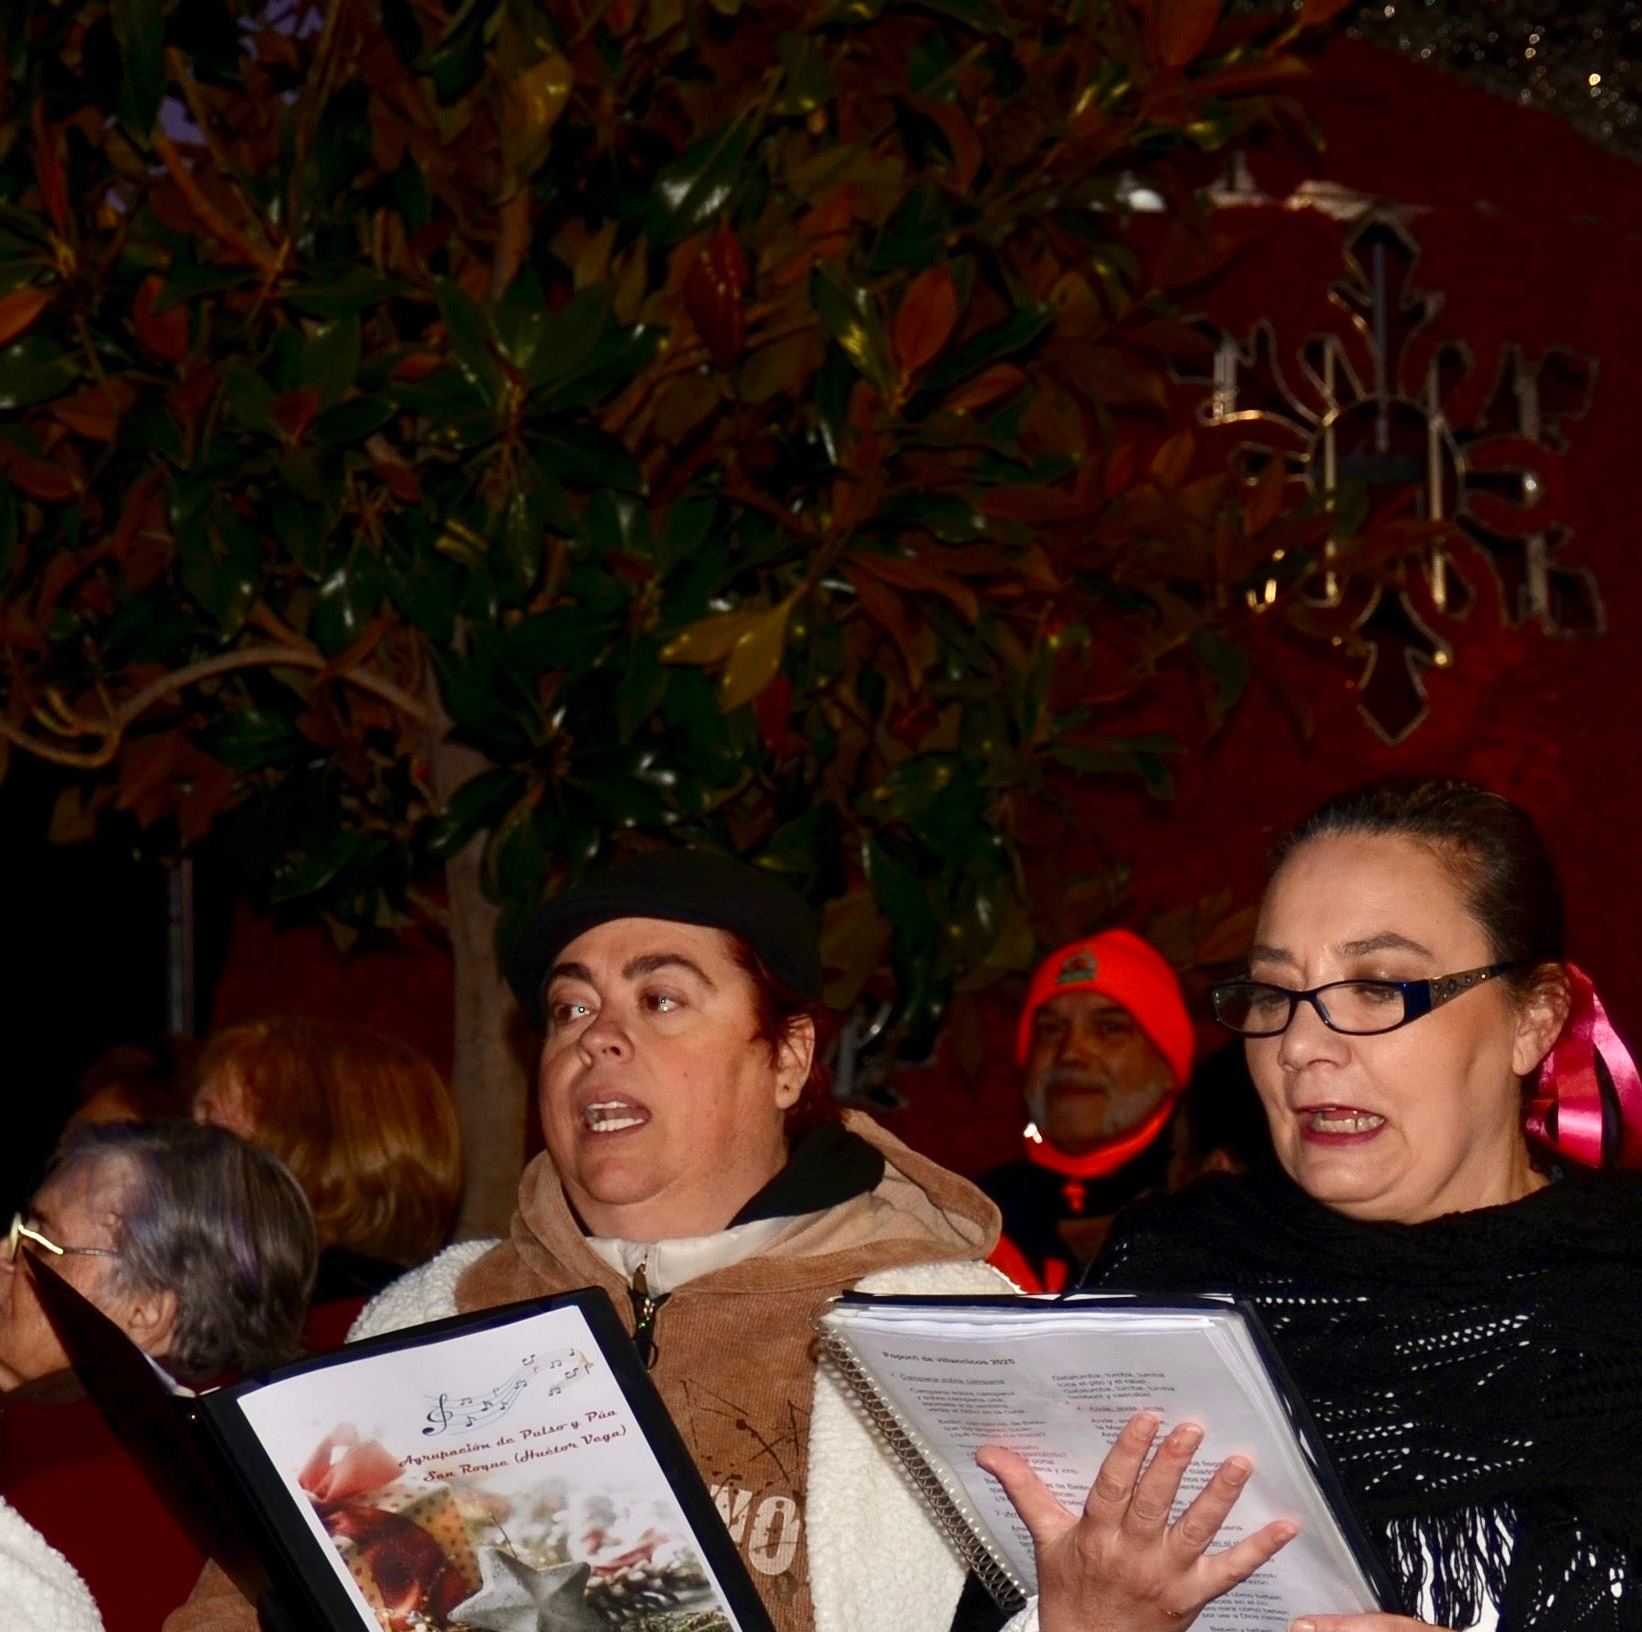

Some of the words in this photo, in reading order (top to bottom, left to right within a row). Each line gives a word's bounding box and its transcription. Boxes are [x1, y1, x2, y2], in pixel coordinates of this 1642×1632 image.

[398, 1443, 492, 1468] Agrupación
[496, 1436, 516, 1447] de
[519, 1422, 569, 1441] Pulso
[570, 1420, 582, 1432] y
[585, 1409, 619, 1423] Púa
[423, 1469, 457, 1482] San
[459, 1459, 510, 1476] Roque
[513, 1442, 580, 1464] (Huétor
[581, 1423, 628, 1447] Vega)
